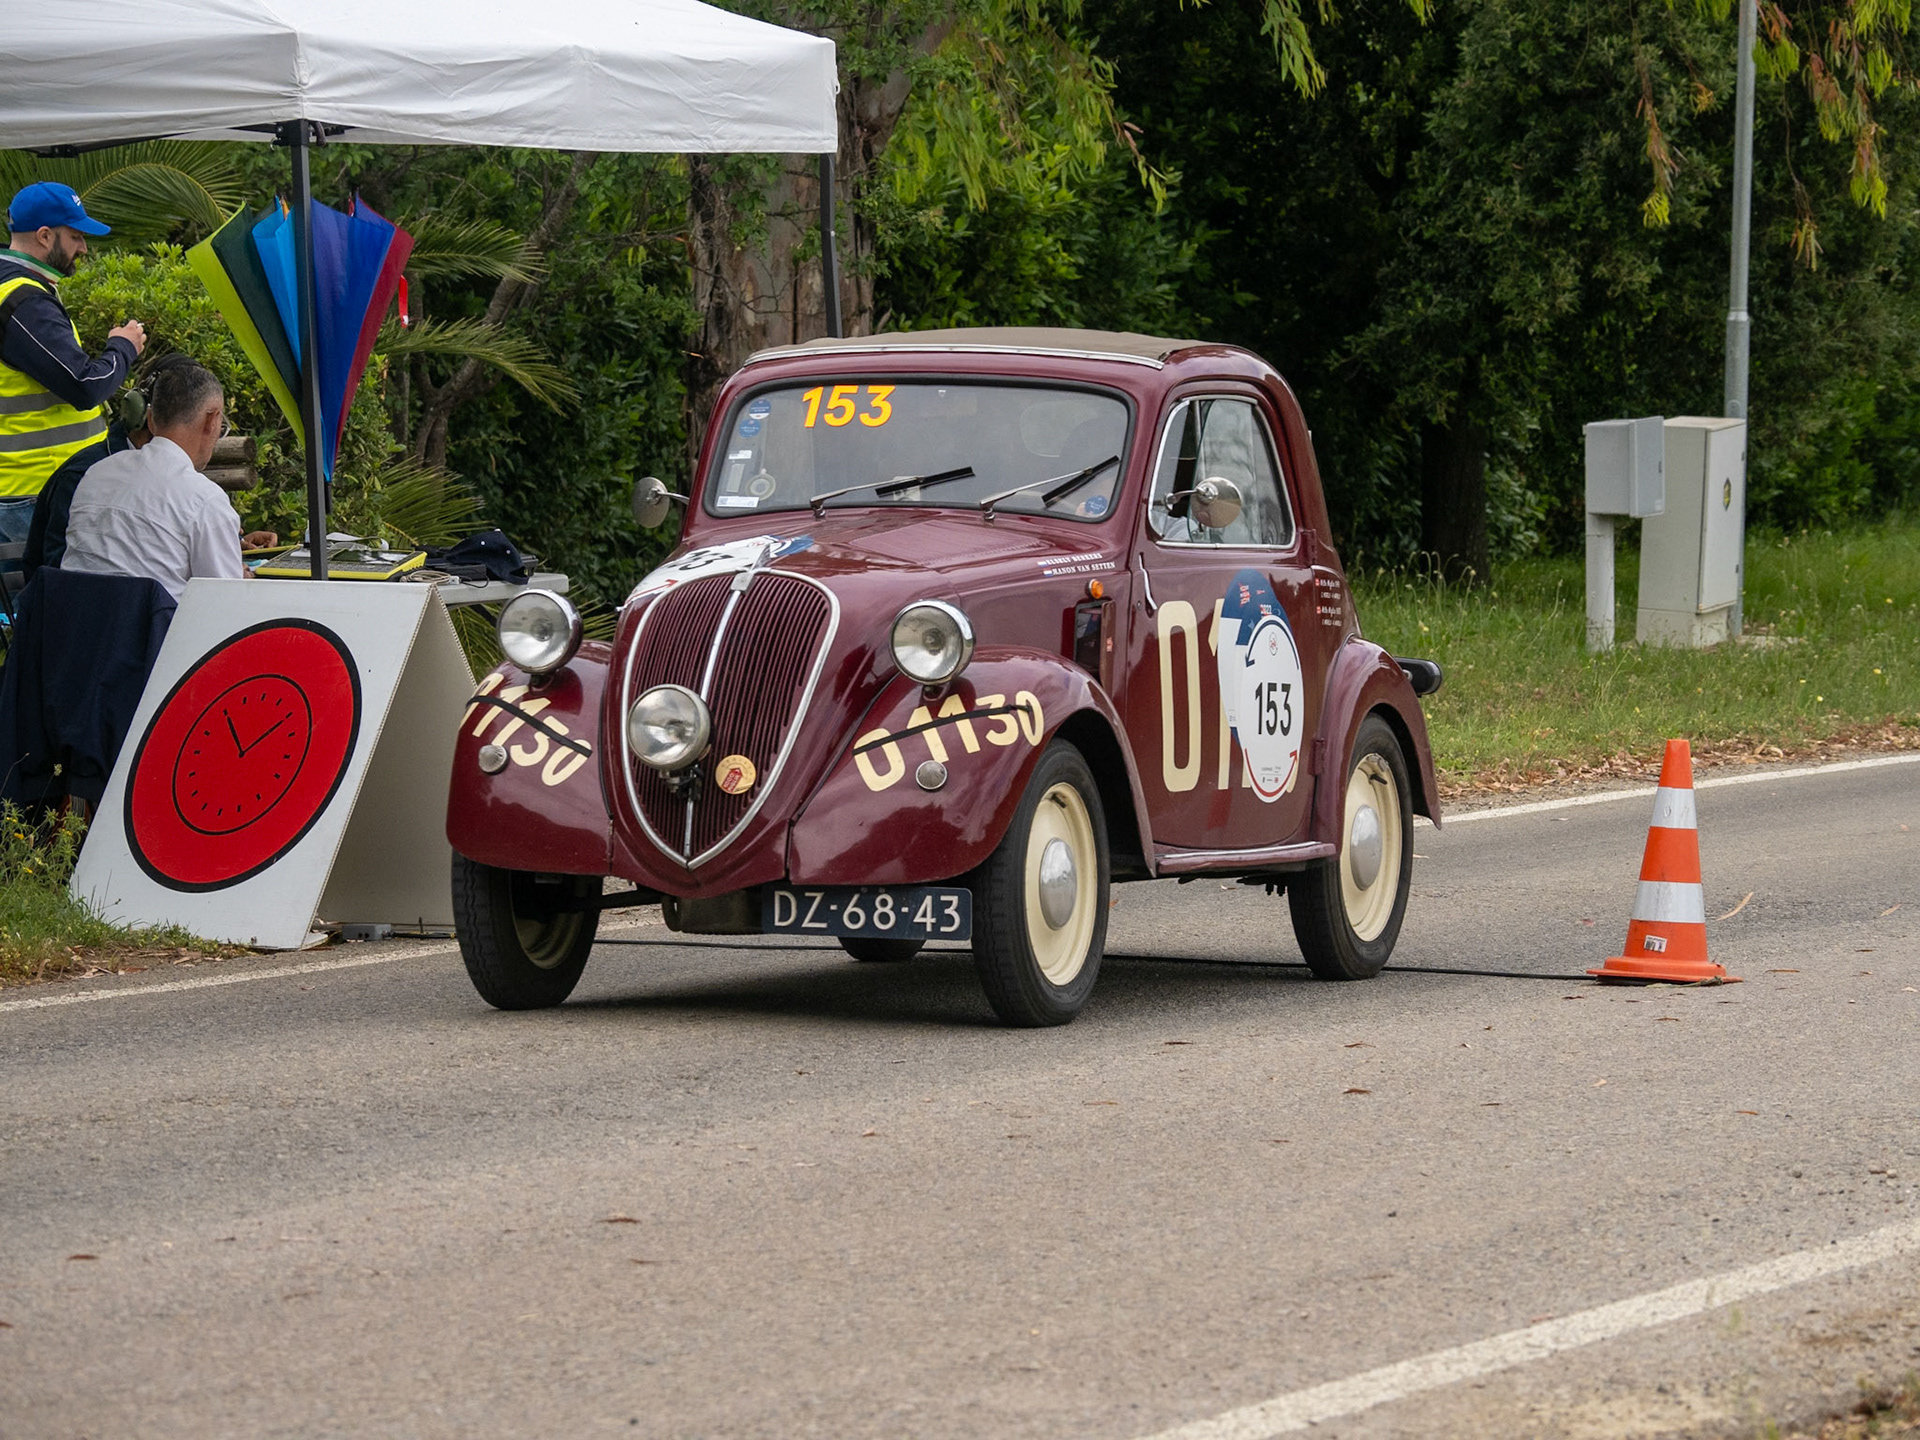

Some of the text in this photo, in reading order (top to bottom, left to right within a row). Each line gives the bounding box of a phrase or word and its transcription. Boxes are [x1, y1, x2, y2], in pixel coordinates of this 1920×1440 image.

[802, 385, 896, 428] 153
[1077, 564, 1091, 572] VAN
[1255, 682, 1292, 736] 153
[774, 890, 961, 932] DZ-68-43
